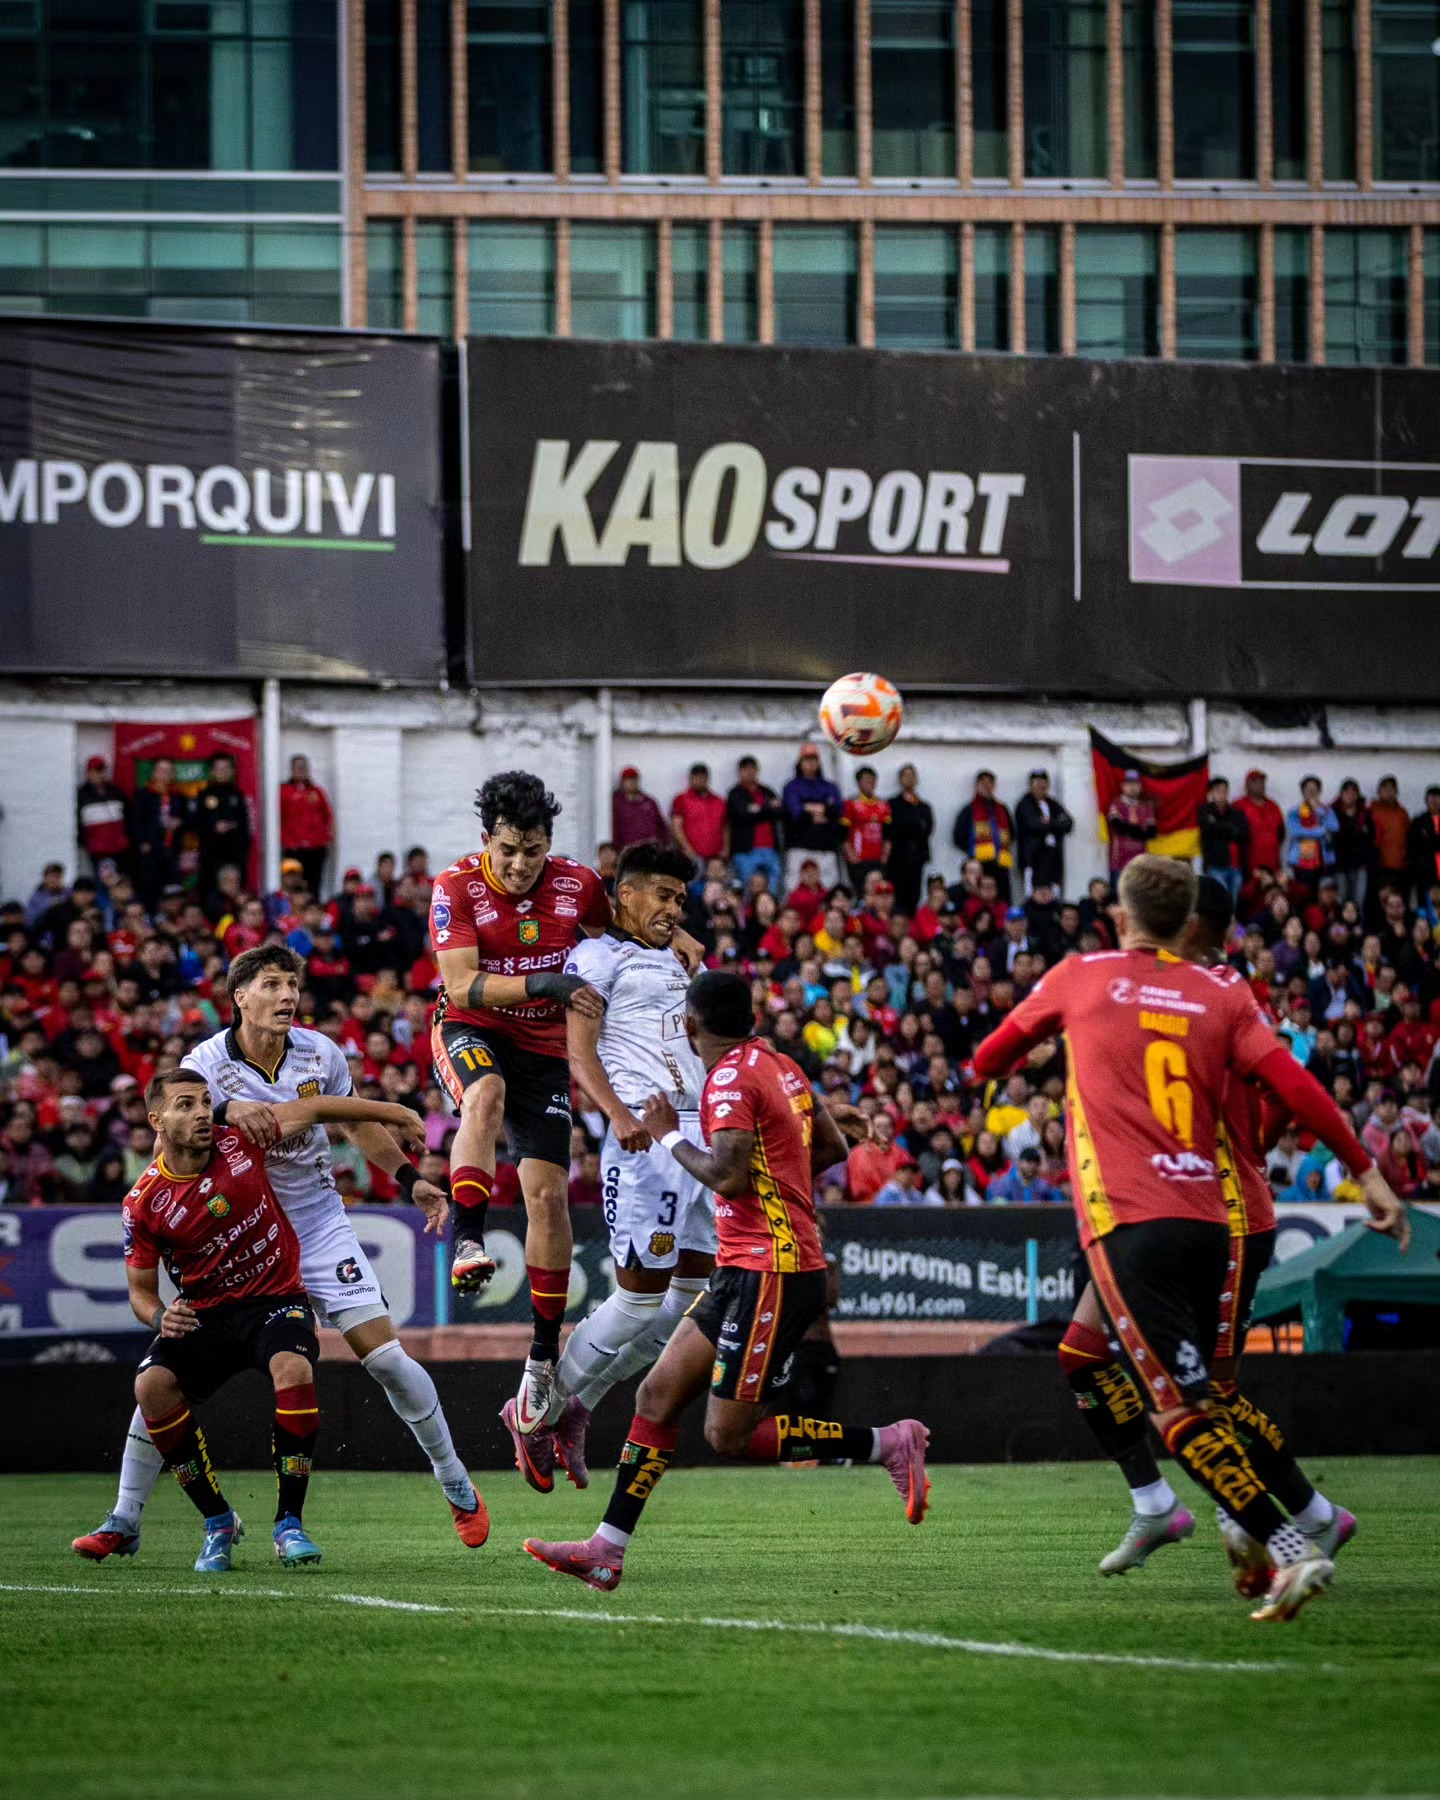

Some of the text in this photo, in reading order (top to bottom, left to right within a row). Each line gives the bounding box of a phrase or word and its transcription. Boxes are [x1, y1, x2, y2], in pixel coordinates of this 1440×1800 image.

[518, 439, 1026, 569] KAO SPORT
[459, 1047, 493, 1071] 18
[1143, 1039, 1195, 1149] 6
[658, 1190, 678, 1227] 3
[841, 1242, 973, 1289] Suprema
[338, 1286, 377, 1298] marathon
